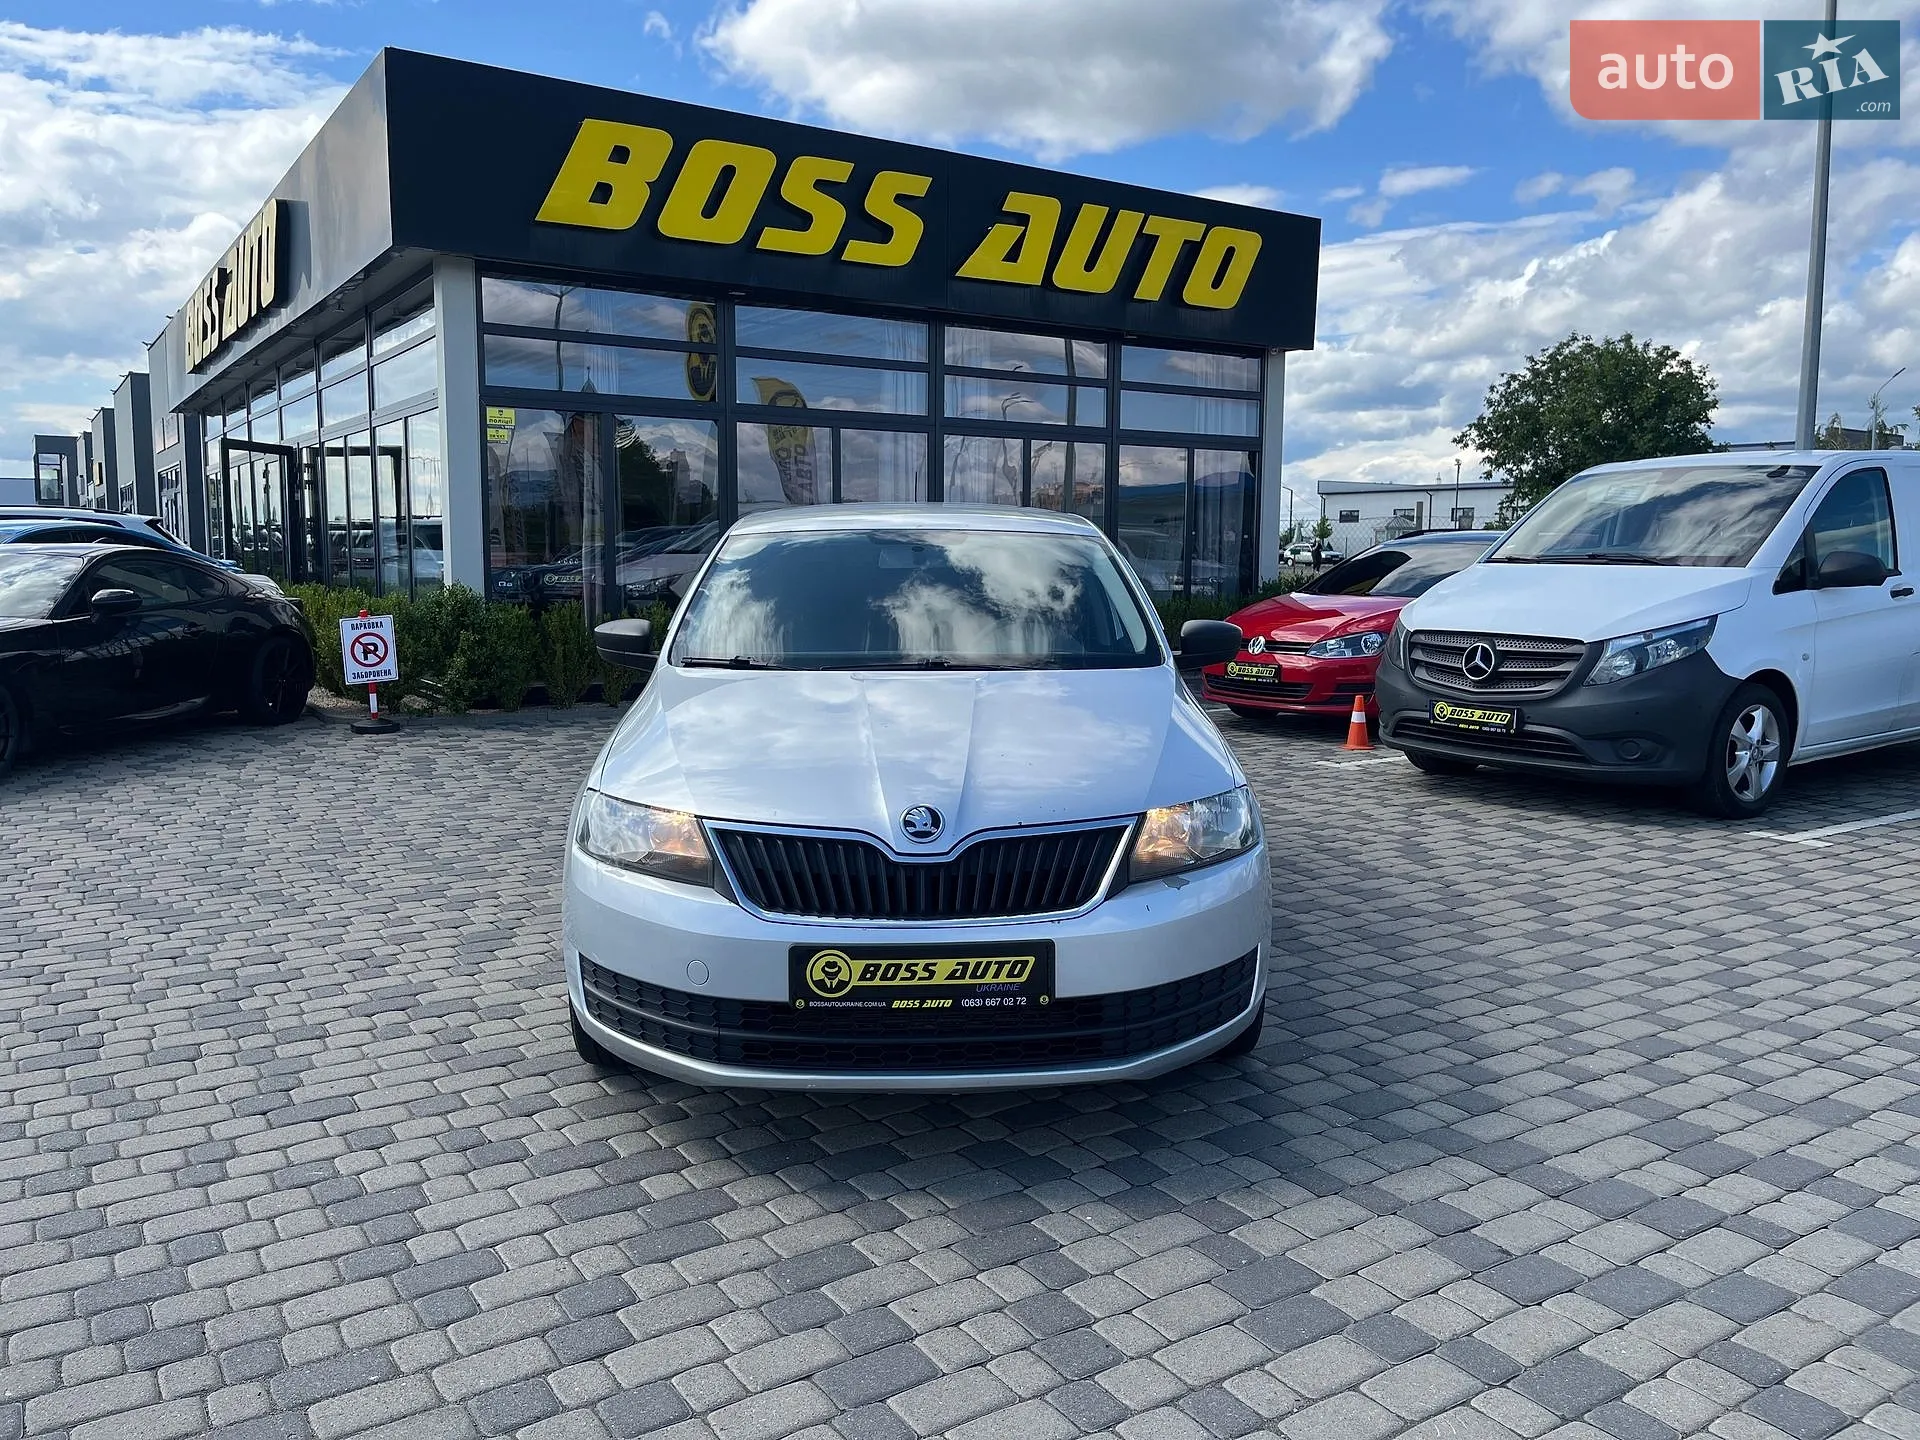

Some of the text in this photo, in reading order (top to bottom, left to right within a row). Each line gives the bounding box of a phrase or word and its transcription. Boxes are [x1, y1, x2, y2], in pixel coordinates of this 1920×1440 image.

[535, 118, 1263, 310] BOSS AUTO
[186, 198, 278, 374] BOSS AUTO
[1449, 708, 1509, 723] BOSS AUTO
[857, 960, 1030, 981] BOSS AUTO
[976, 984, 1021, 992] UKRAINE
[891, 1000, 920, 1008] BOSS
[922, 999, 953, 1008] AUTO
[961, 998, 983, 1007] (063)
[985, 998, 1001, 1007] 667
[1003, 998, 1014, 1006] 02
[1016, 997, 1027, 1005] 72
